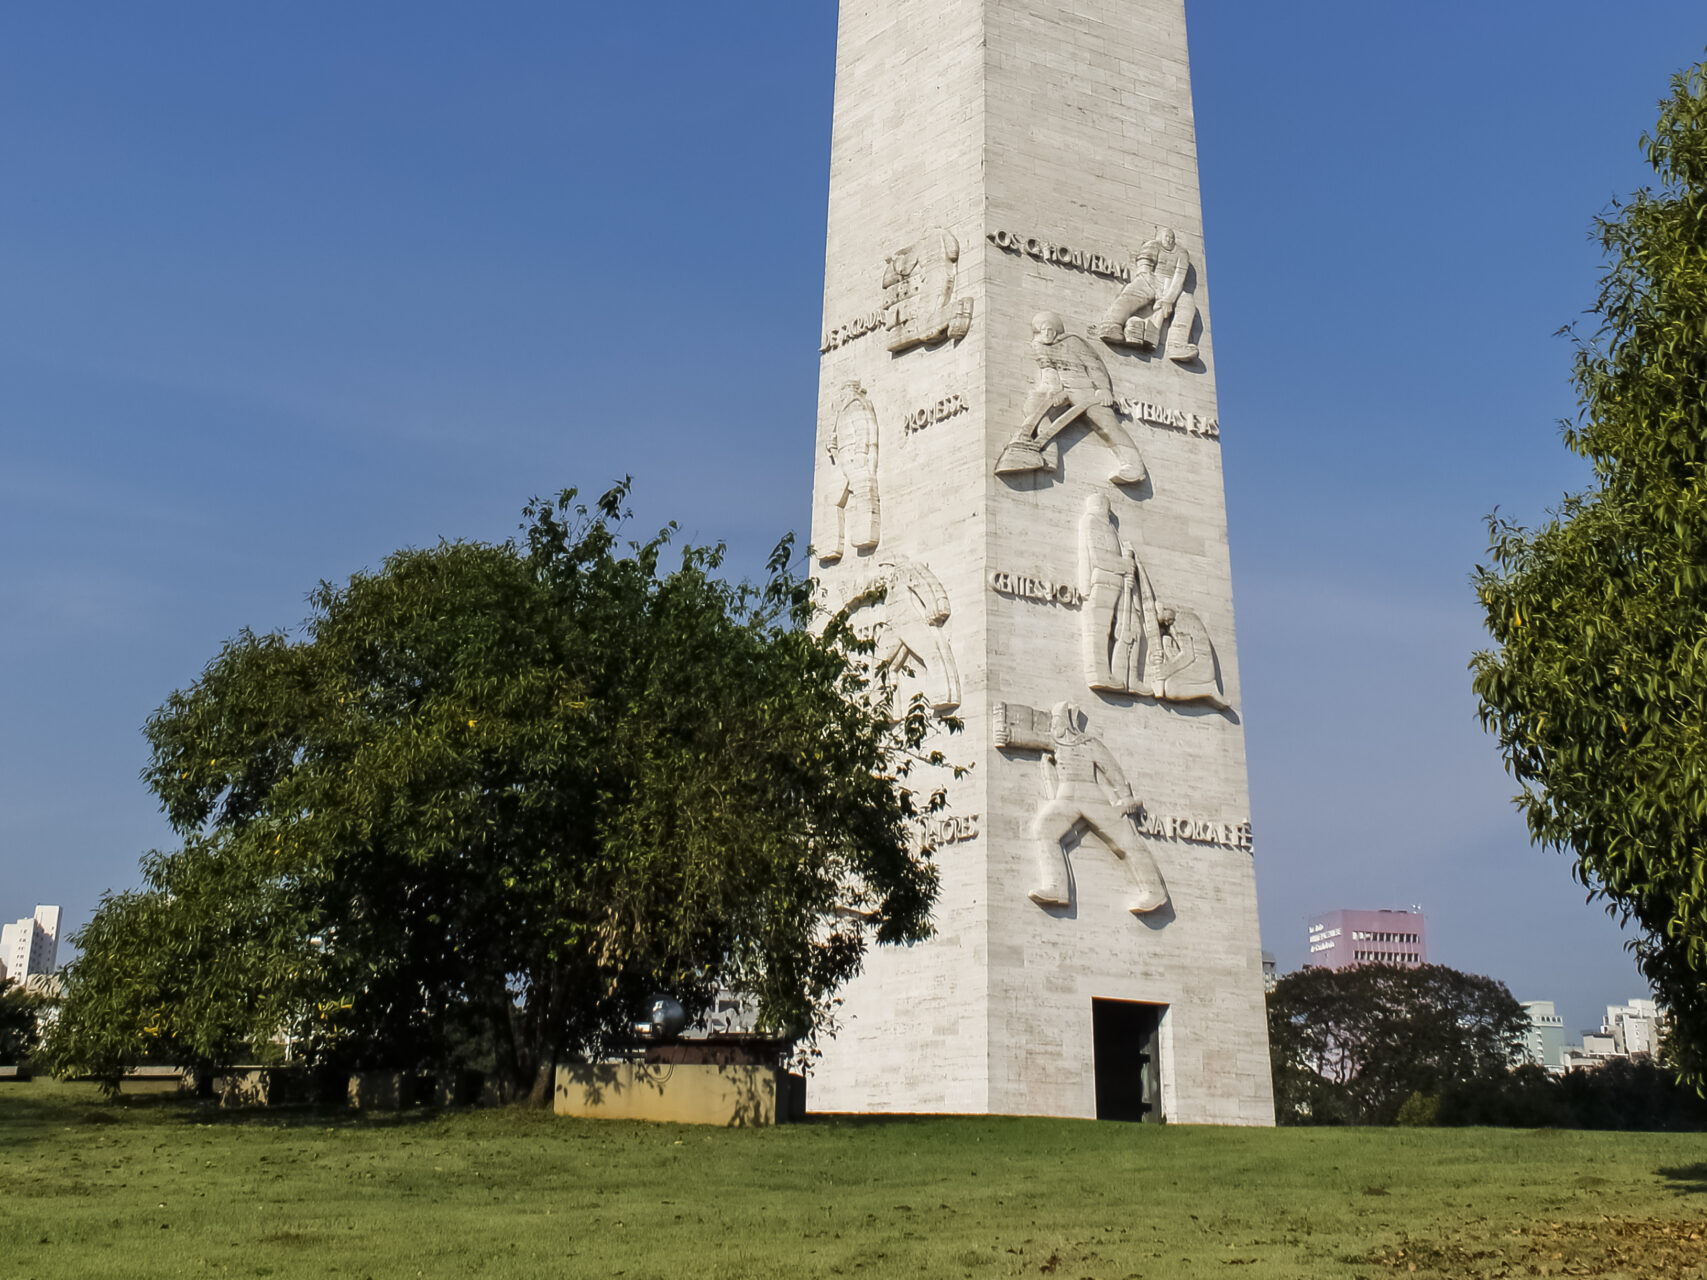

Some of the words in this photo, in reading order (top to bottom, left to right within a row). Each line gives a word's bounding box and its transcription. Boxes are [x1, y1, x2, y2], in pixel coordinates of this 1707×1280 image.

[904, 392, 969, 436] PROMESSA
[1132, 399, 1187, 429] TERRAS
[990, 570, 1046, 600] GENTES
[1045, 579, 1083, 607] POR
